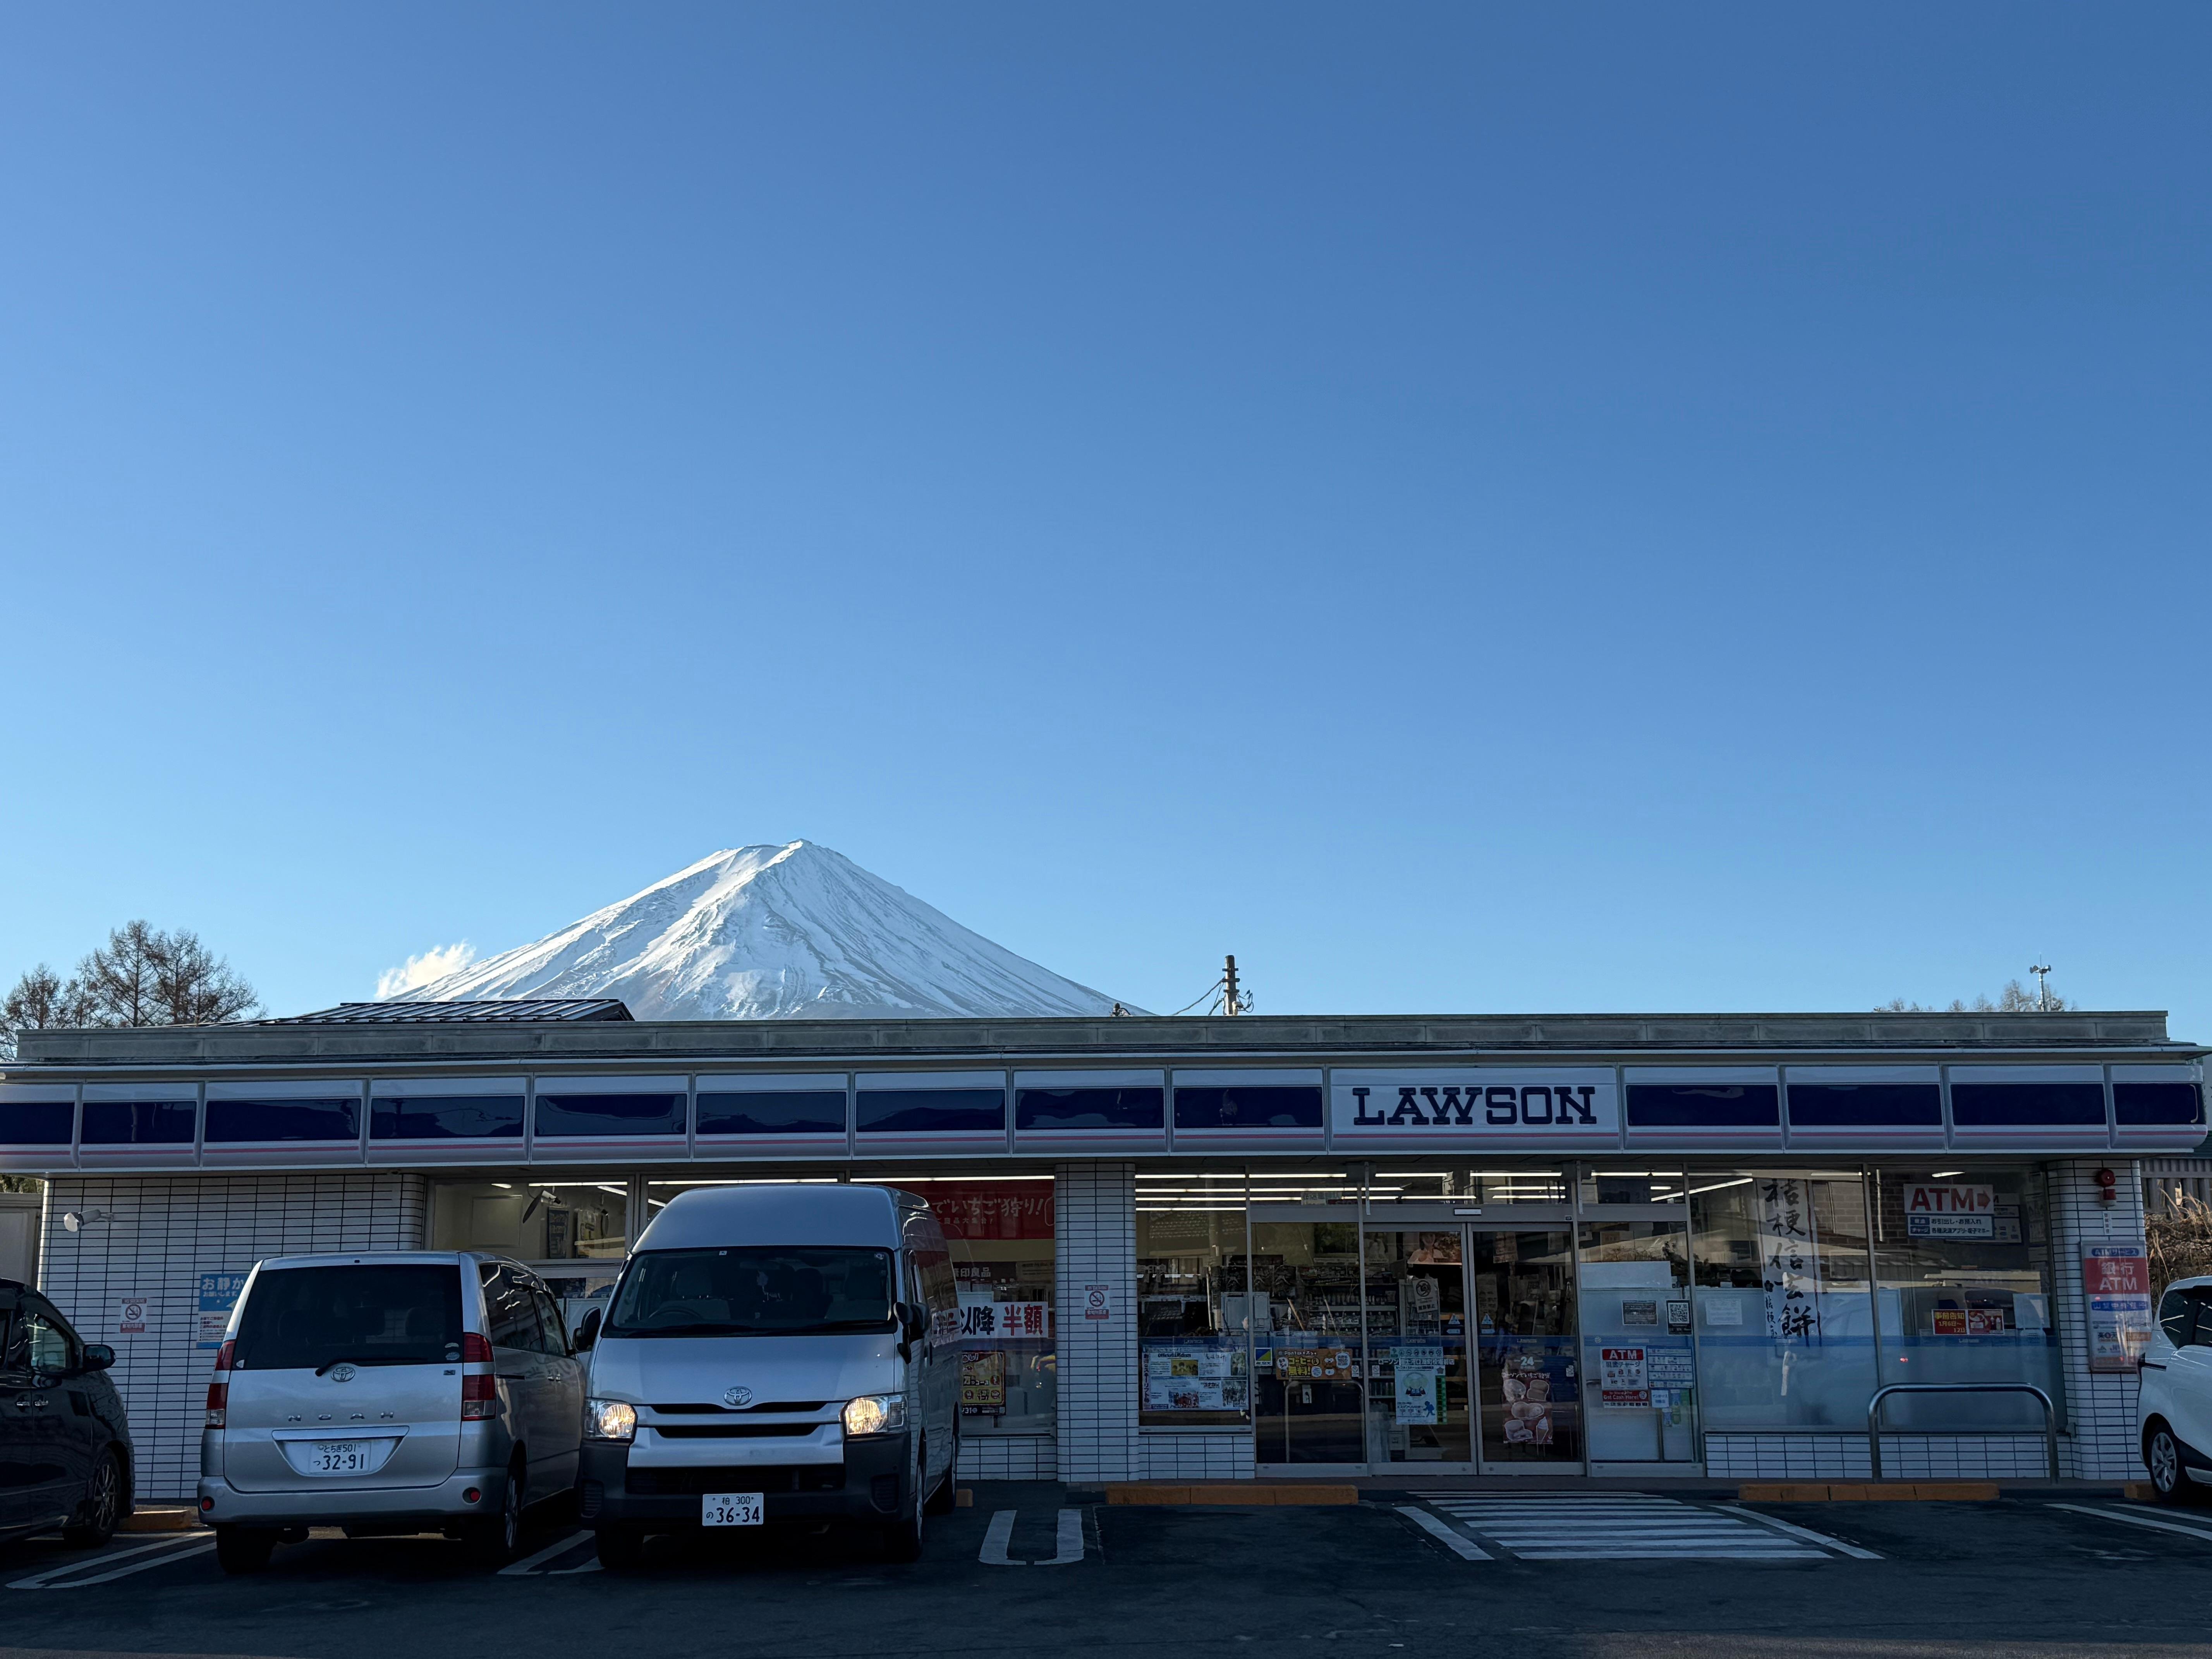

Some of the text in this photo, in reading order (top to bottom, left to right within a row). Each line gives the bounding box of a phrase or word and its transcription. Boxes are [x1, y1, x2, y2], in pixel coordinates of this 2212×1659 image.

[1353, 1086, 1597, 1125] LAWSON
[1910, 1188, 1975, 1211] ATM
[2101, 1262, 2134, 1275] 銀行
[2099, 1277, 2138, 1291] ATM
[1002, 1304, 1043, 1336] 半額
[1520, 1356, 1534, 1366] 24
[1609, 1350, 1637, 1360] ATM
[288, 1412, 394, 1422] NOAH
[322, 1454, 364, 1470] 32-91
[736, 1496, 751, 1504] 300
[716, 1506, 760, 1523] 36-34
